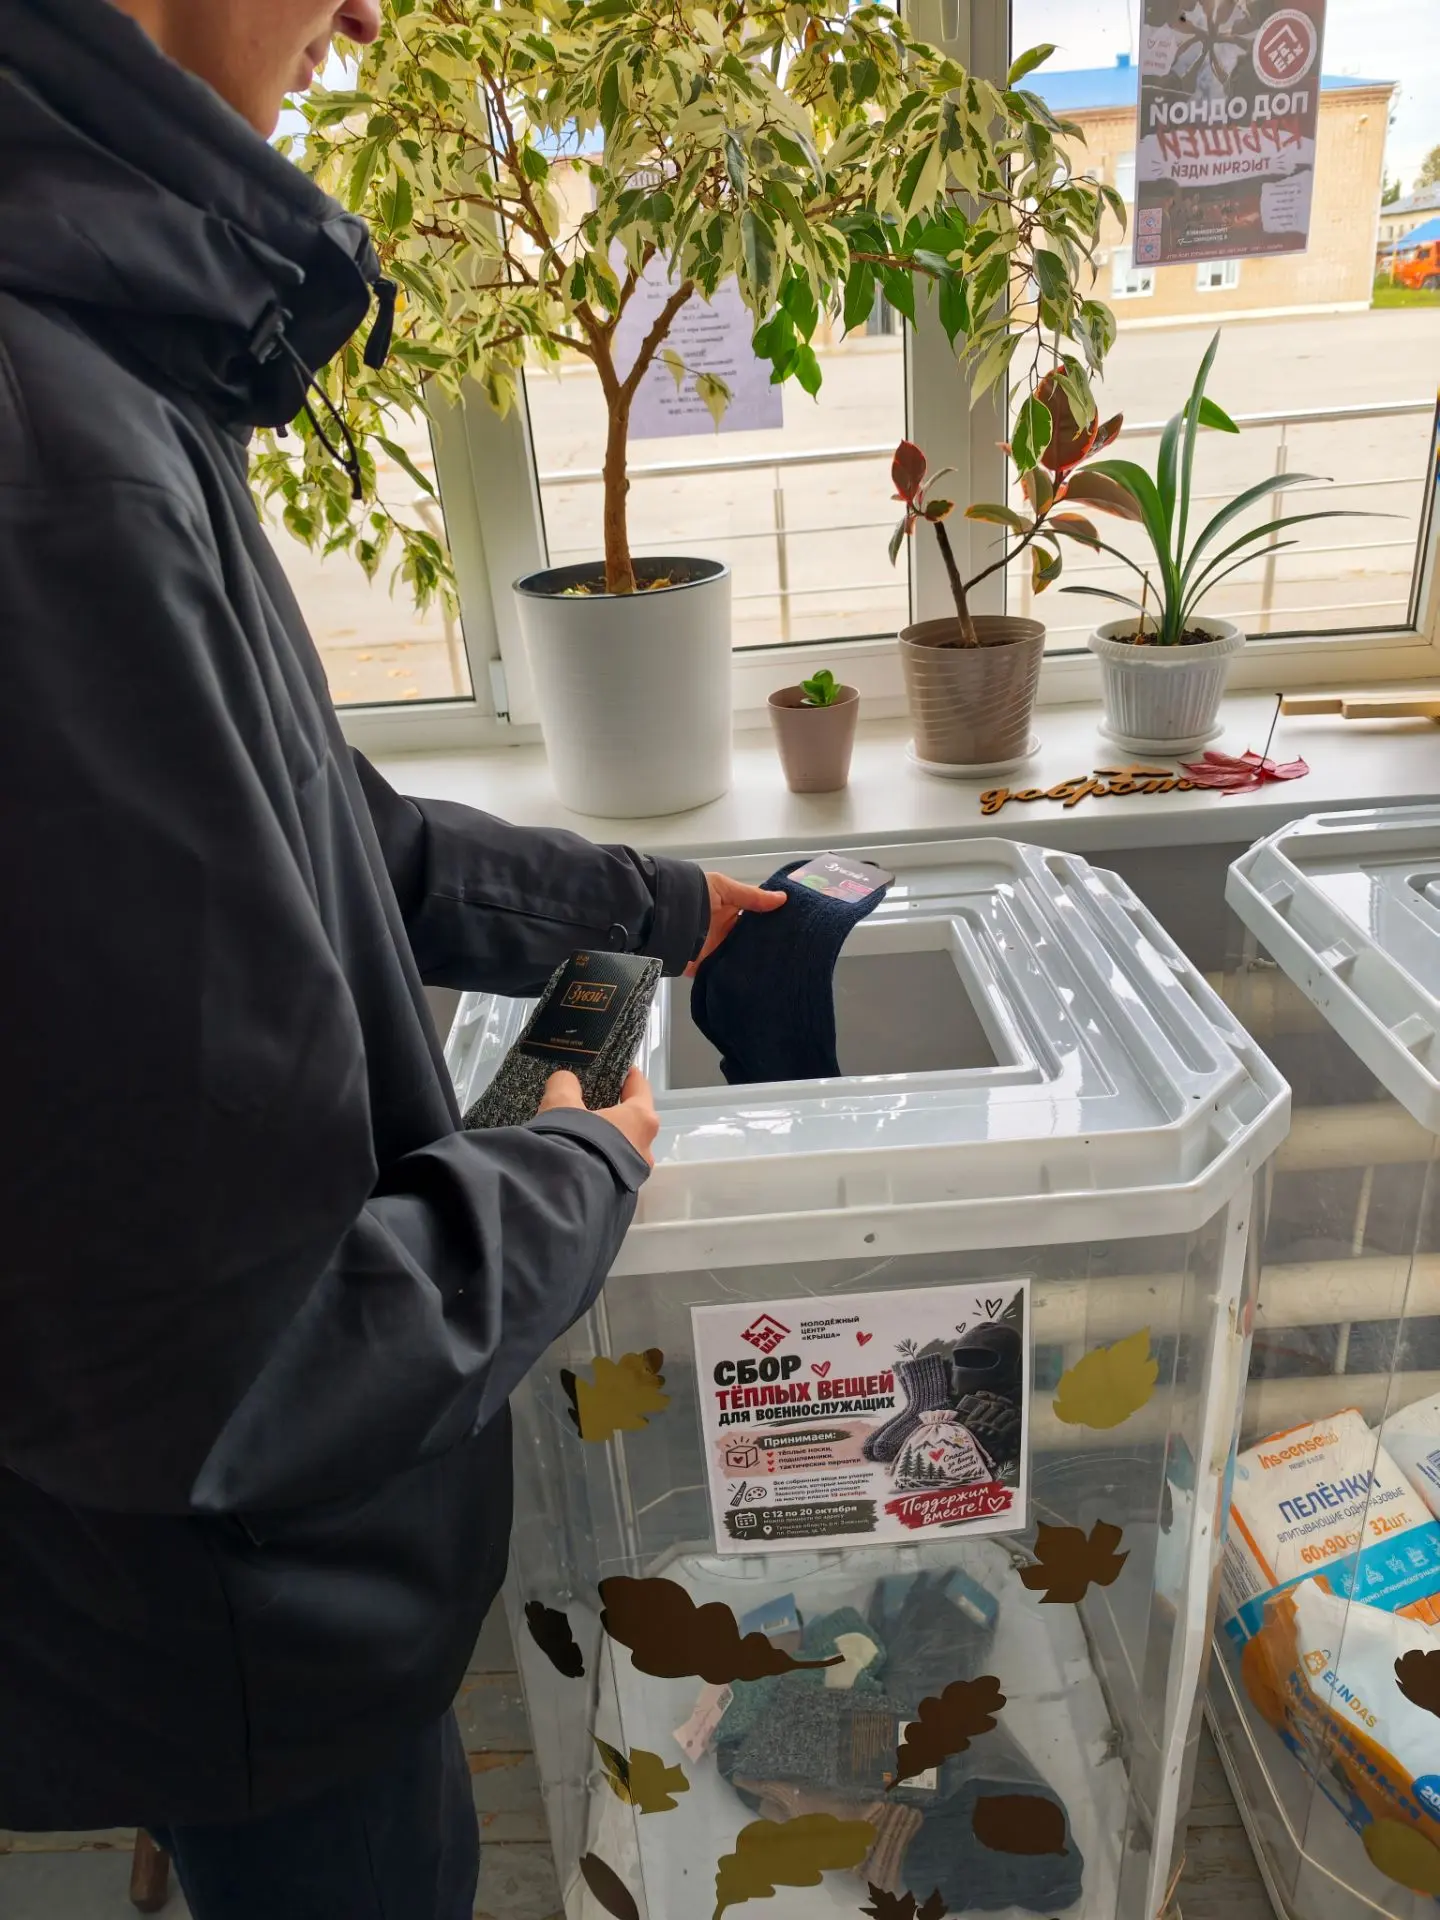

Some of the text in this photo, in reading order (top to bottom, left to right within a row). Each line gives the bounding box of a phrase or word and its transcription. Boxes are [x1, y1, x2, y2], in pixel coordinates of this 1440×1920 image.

[801, 1316, 860, 1327] МОЛОДЁЖНЫЙ
[801, 1327, 826, 1335] ЦЕНТР
[802, 1332, 841, 1341] «КРЫША»
[713, 1355, 802, 1386] СБОР
[715, 1369, 895, 1411] ТЁПЛЫХ ВЕЩЕЙ
[718, 1396, 895, 1427] ДЛЯ ВОЕННОСЛУЖАЩИХ
[763, 1432, 837, 1448] Принимаем:
[800, 1508, 813, 1516] 20
[815, 1505, 857, 1514] октября
[899, 1486, 989, 1516] Поддержим
[922, 1496, 984, 1525] вместе!
[1278, 1469, 1382, 1524] ПЕЛЁНКИ
[1276, 1486, 1406, 1543] ВПИТЫВАЮЩИЕ ОДНОРАЗОВЫЕ
[1322, 1670, 1378, 1728] ELINDAS
